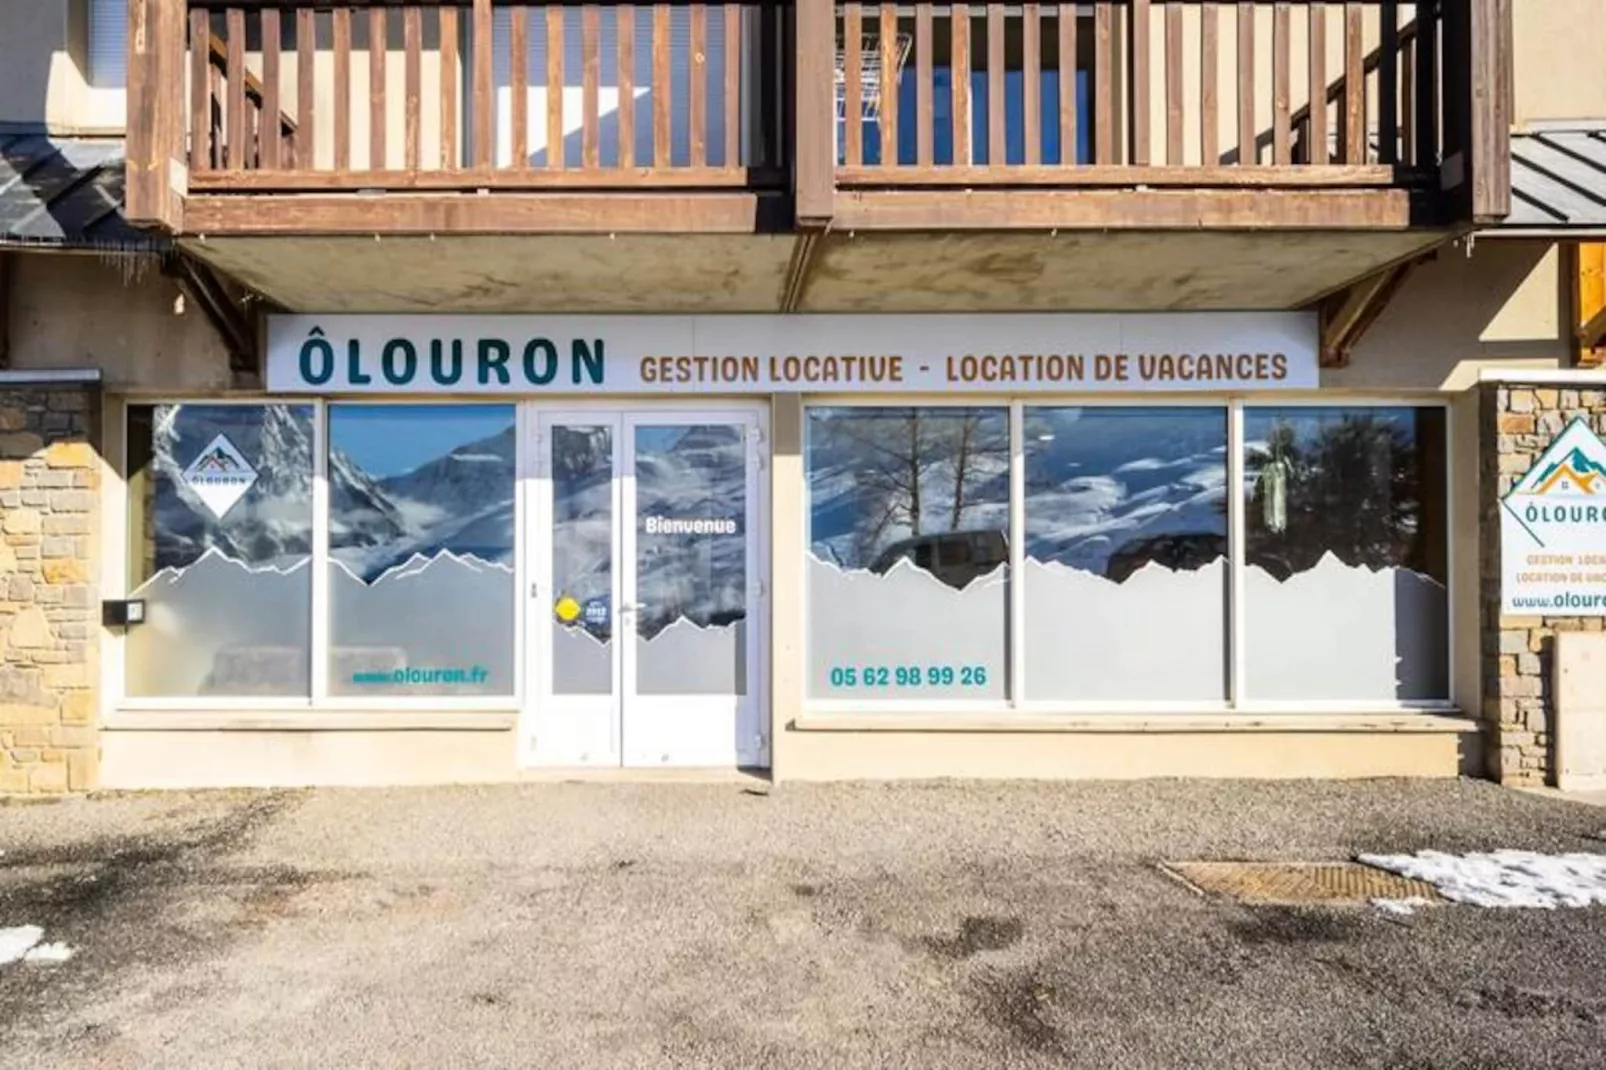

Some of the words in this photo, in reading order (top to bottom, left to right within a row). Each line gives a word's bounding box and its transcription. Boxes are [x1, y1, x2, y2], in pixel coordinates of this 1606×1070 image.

[299, 326, 606, 385] ÔLOURON
[640, 356, 759, 383] GESTION
[770, 355, 903, 382] LOCATIVE
[946, 354, 1084, 382] LOCATION
[1095, 354, 1129, 381] DE
[1139, 353, 1287, 381] VACANCES
[645, 516, 737, 534] Bienvenue
[353, 666, 487, 683] .olouron.fr
[831, 667, 857, 686] 05
[863, 667, 889, 686] 62
[895, 666, 922, 685] 98
[927, 666, 954, 685] 99
[960, 666, 986, 685] 26
